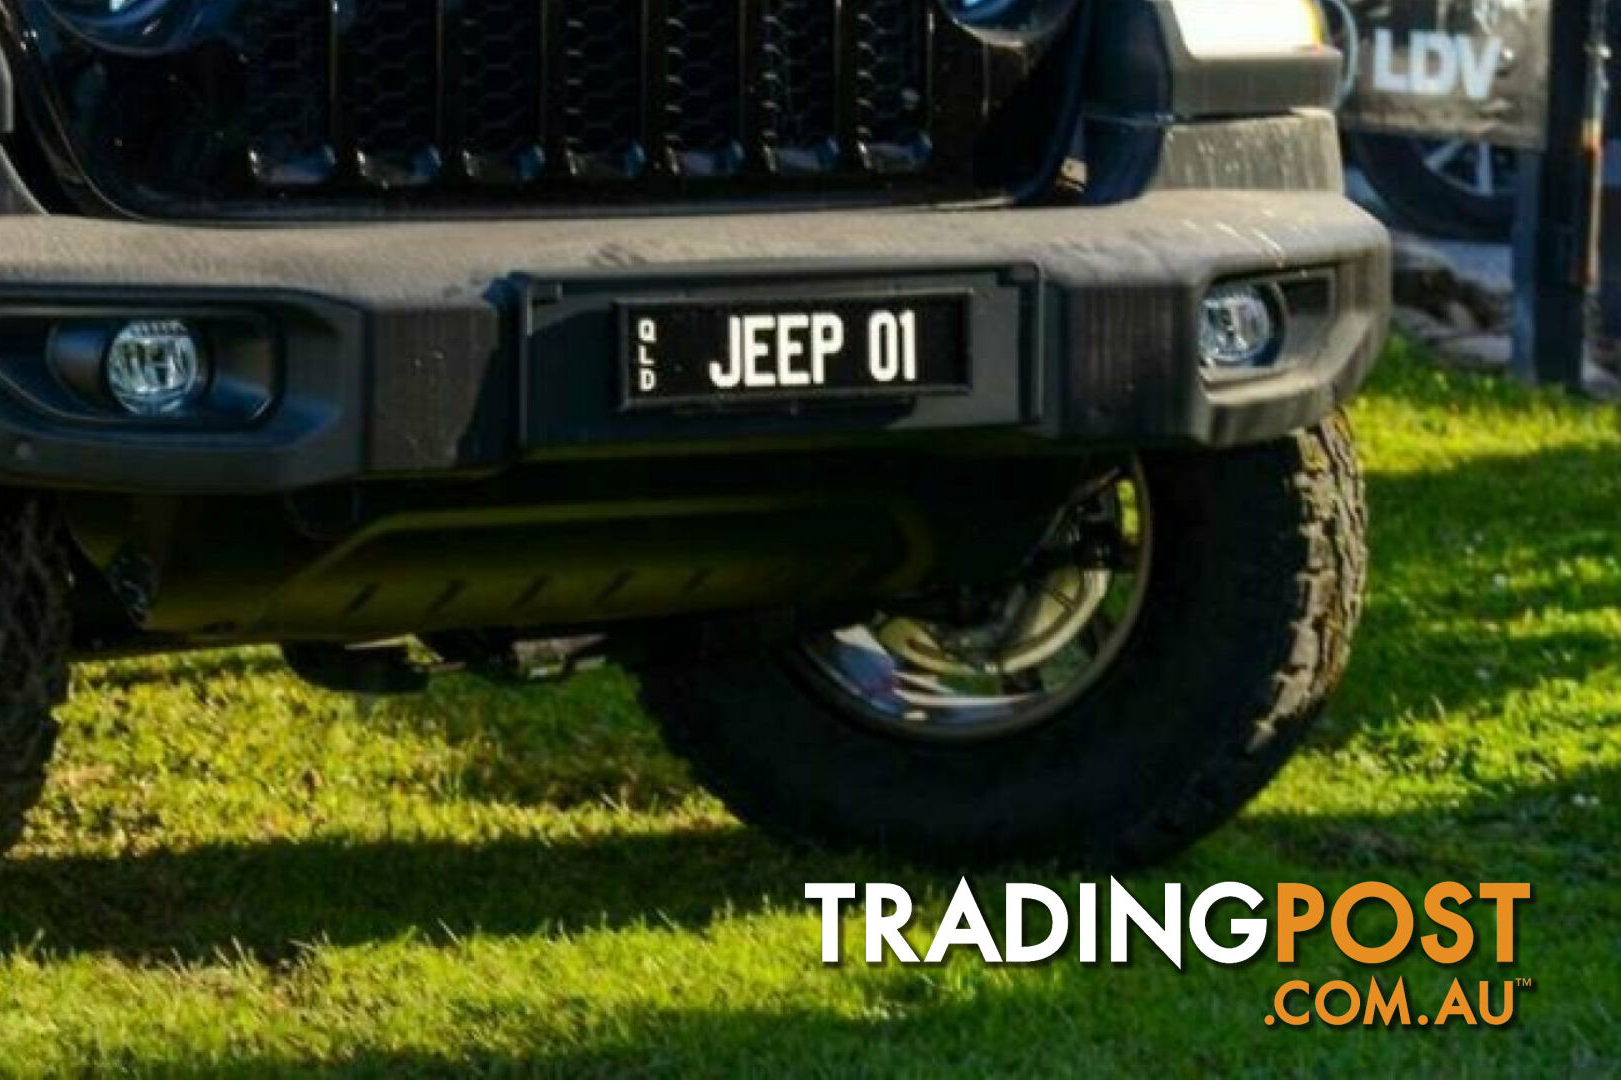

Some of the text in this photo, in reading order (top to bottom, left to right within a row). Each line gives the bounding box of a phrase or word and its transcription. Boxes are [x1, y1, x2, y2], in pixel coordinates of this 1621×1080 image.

[1372, 27, 1502, 99] LDV
[637, 317, 657, 392] QLD
[708, 309, 916, 388] JEEP 01
